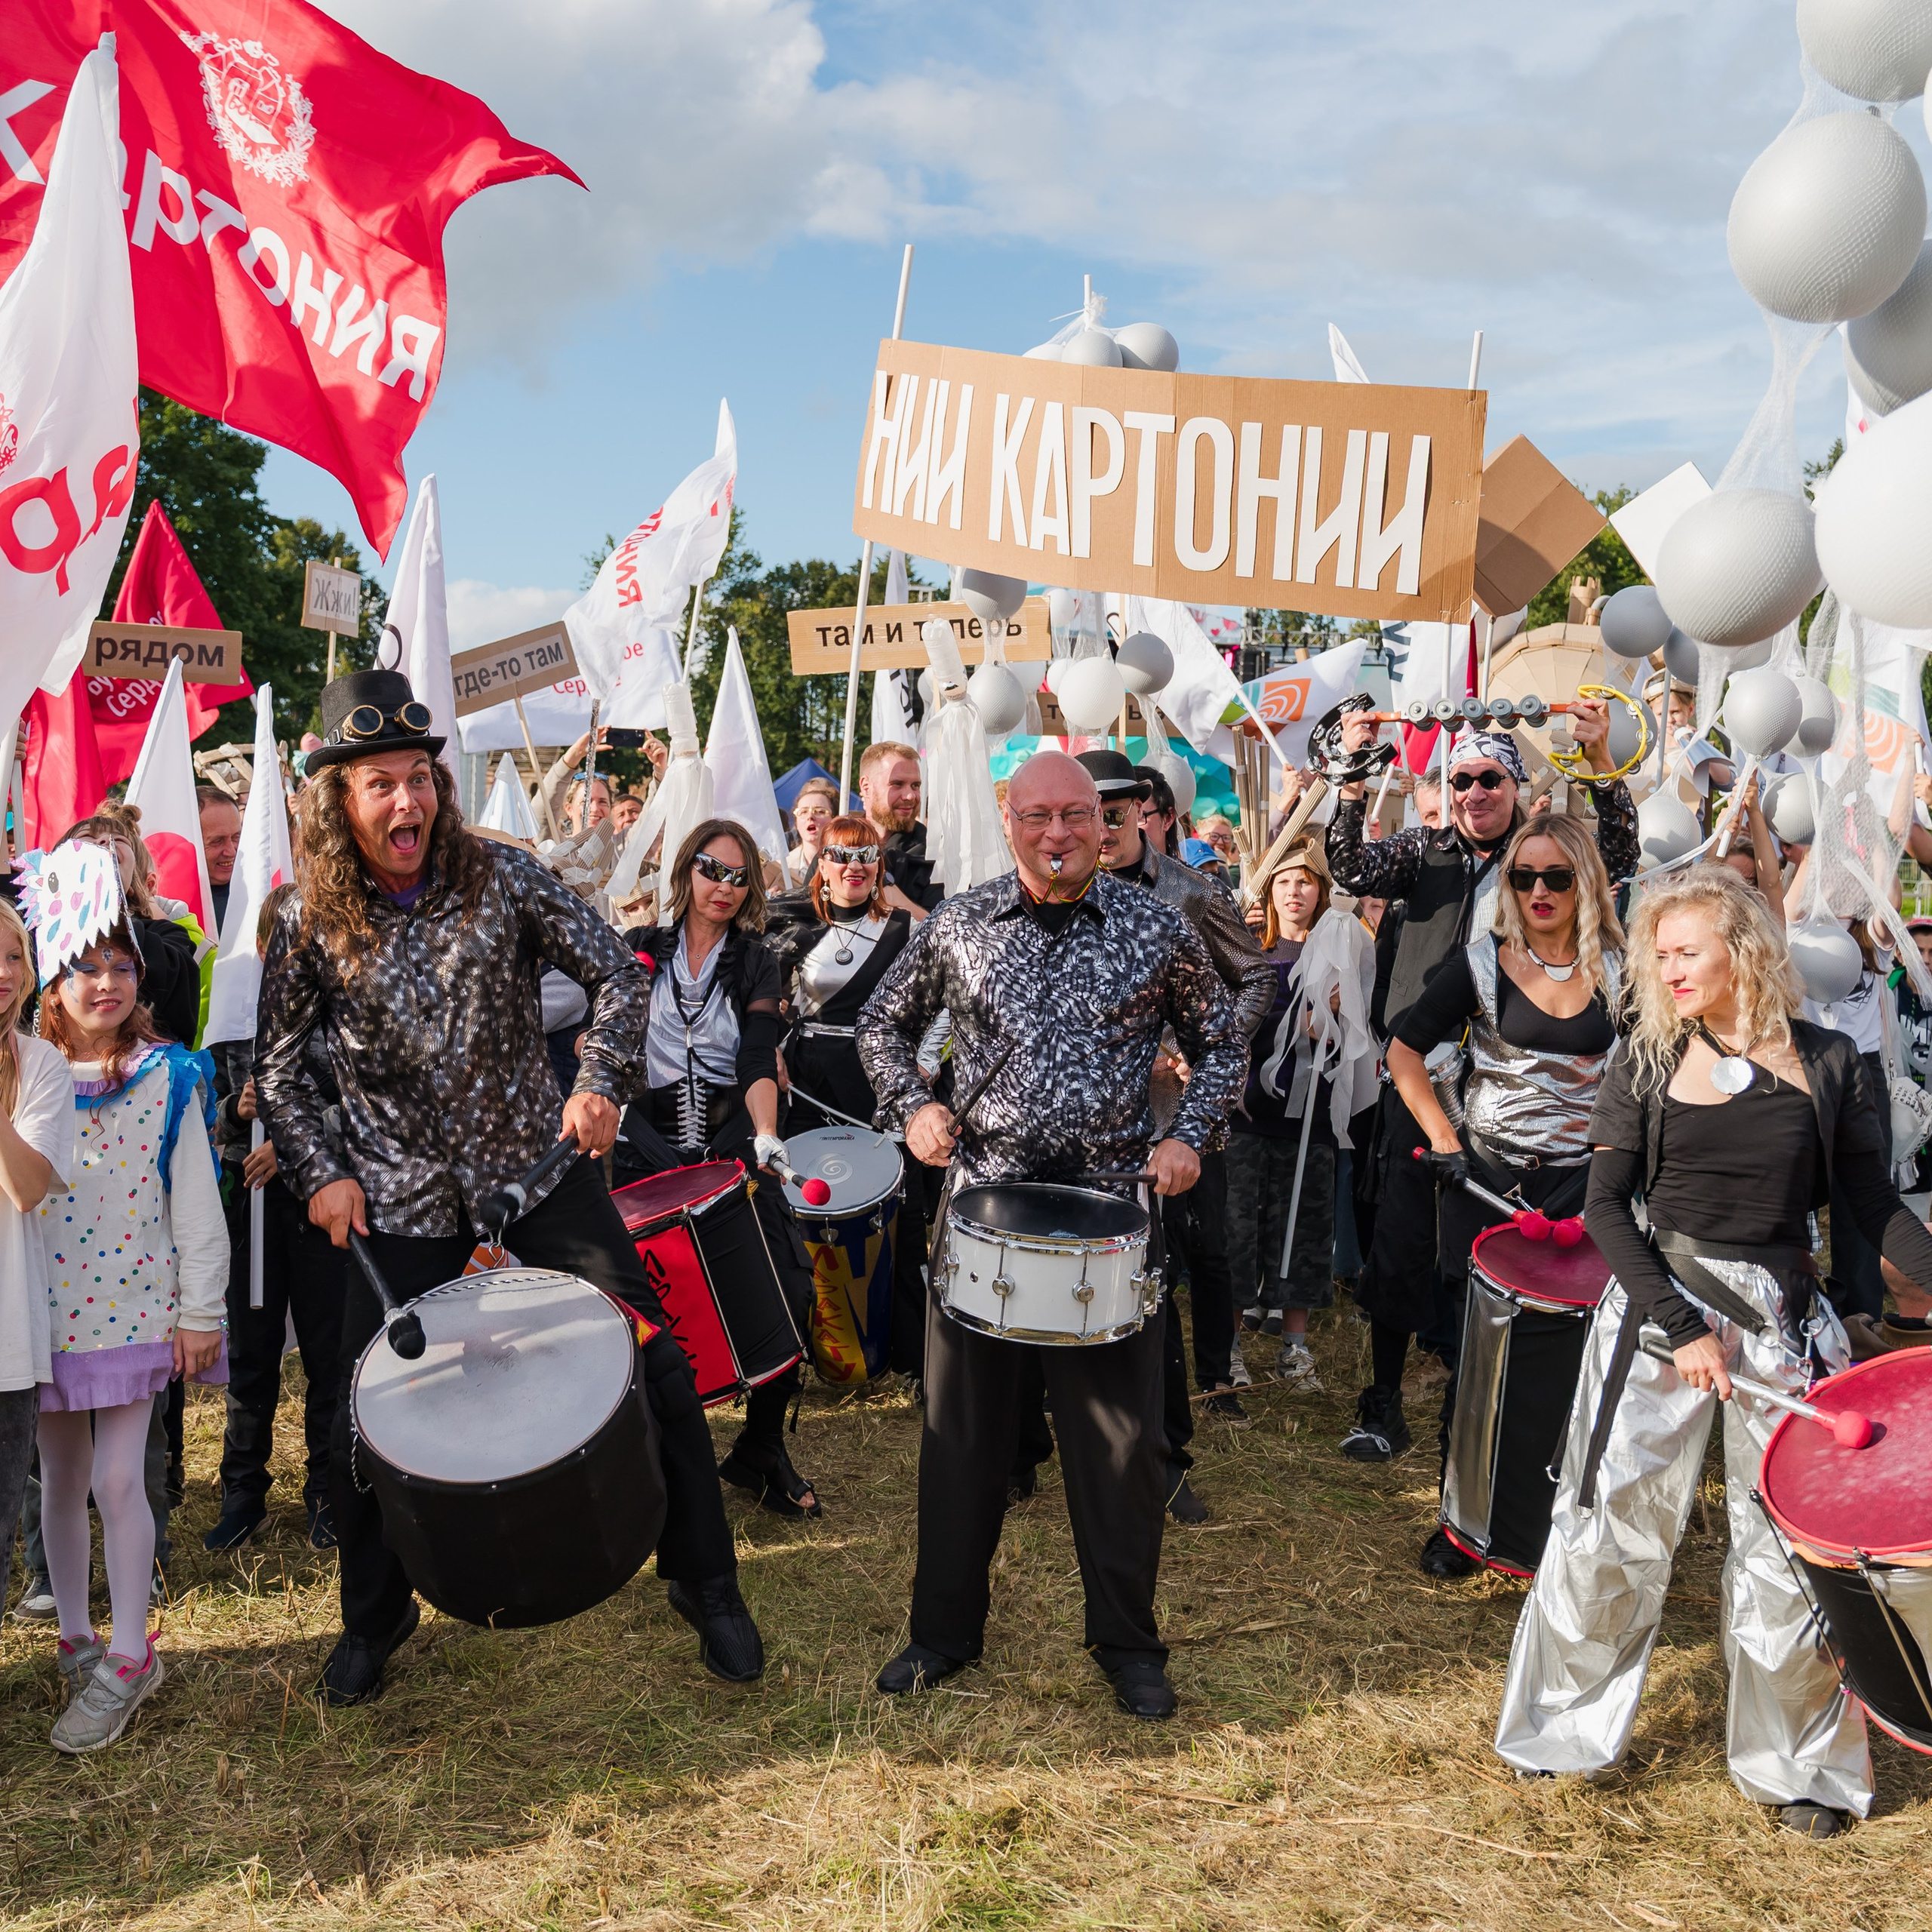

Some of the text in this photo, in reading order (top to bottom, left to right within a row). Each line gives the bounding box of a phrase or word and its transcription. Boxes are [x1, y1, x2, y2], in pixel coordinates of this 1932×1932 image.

[0, 78, 441, 404] Кртония
[862, 370, 1432, 595] НИИ КАРТОНИИ
[95, 637, 224, 668] рядом
[885, 622, 903, 643] и
[913, 617, 1022, 645] тперь
[453, 641, 564, 698] где-то там
